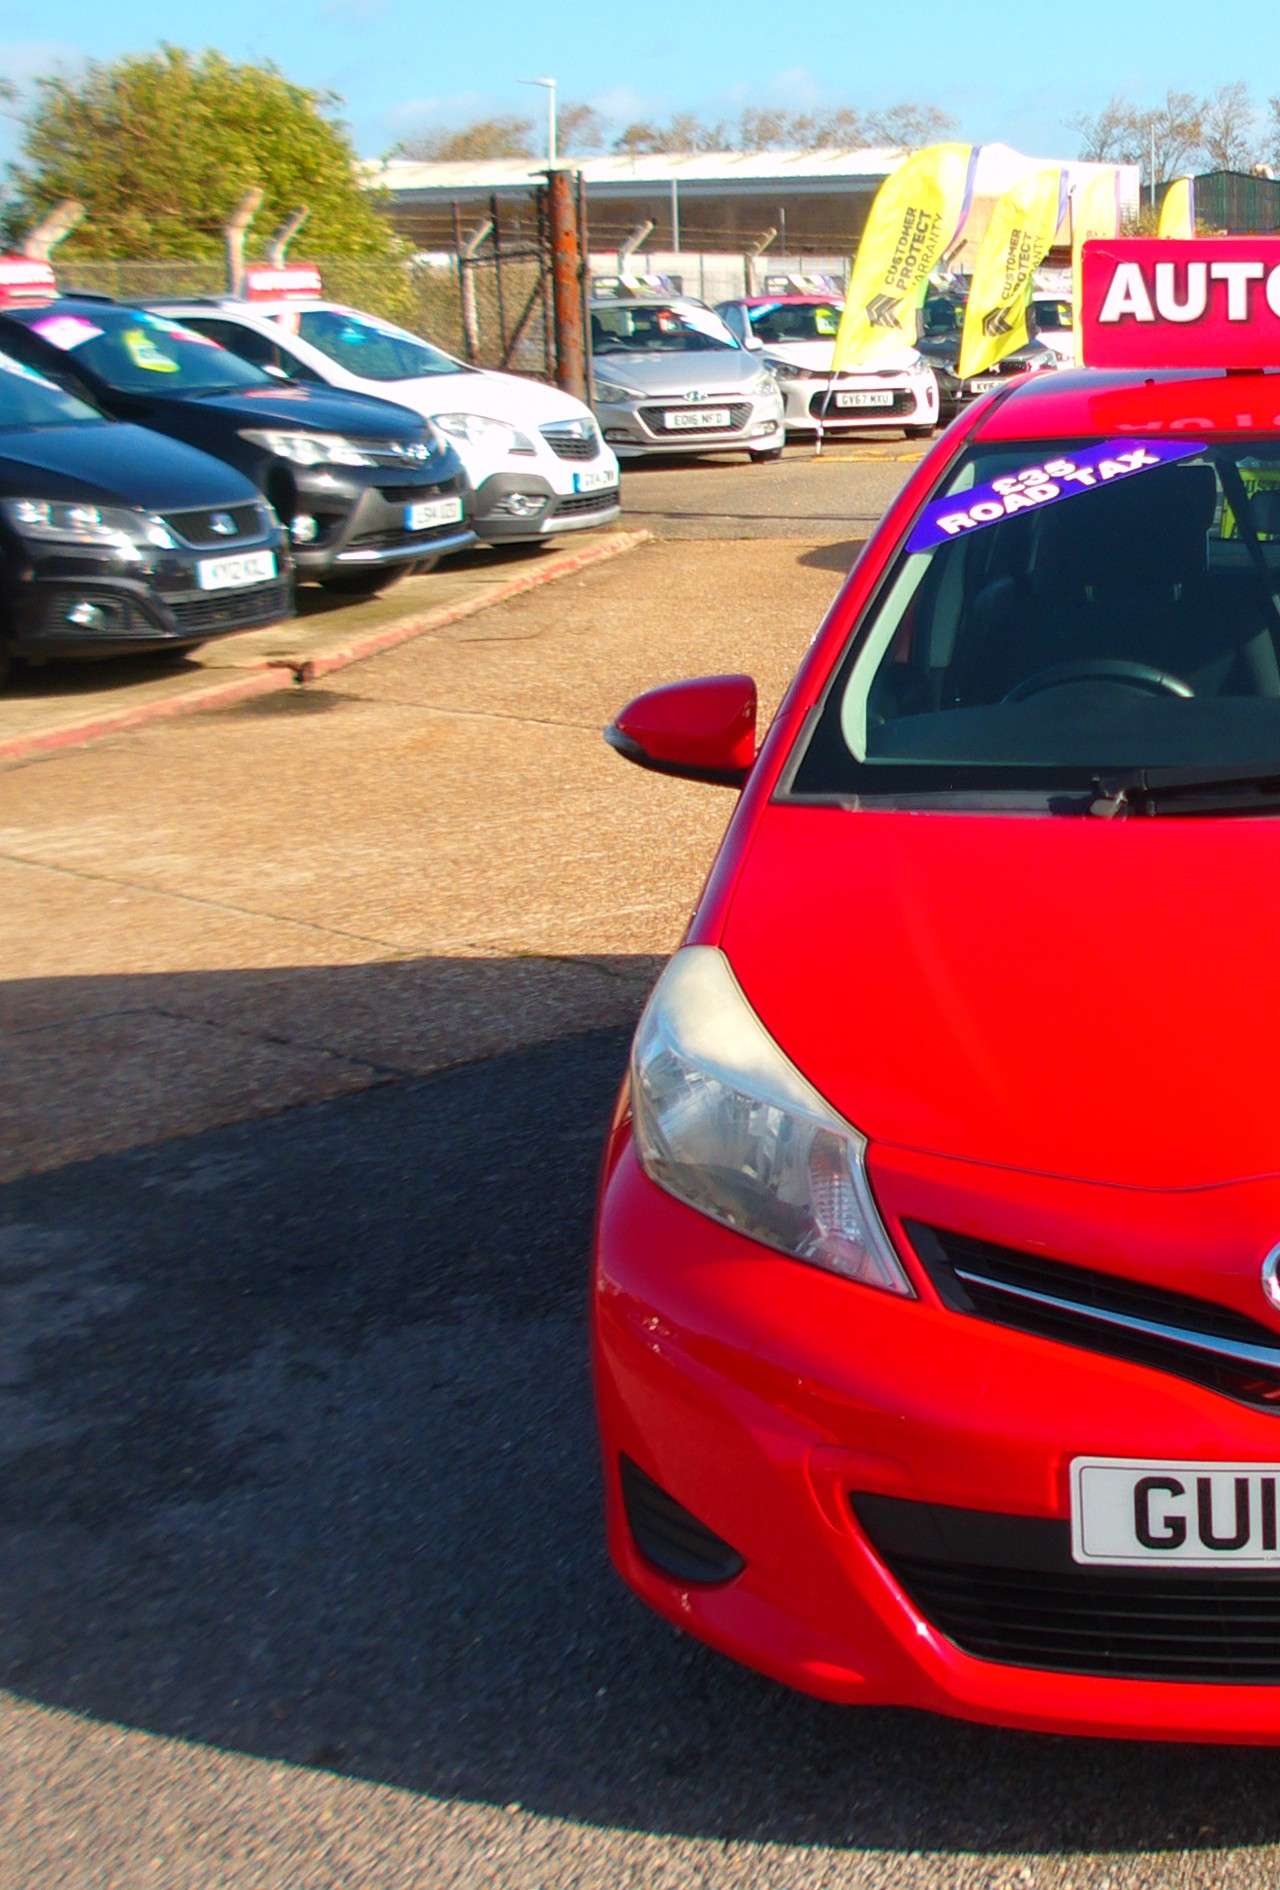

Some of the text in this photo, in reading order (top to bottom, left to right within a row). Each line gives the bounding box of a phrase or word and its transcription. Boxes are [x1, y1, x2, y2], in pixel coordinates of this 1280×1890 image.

[885, 206, 917, 285] CUSTOMER
[896, 209, 931, 290] PROTECT
[912, 212, 943, 285] ARRANTY
[1001, 228, 1022, 300] CUSTOMER
[1010, 232, 1032, 297] OTECT
[936, 448, 1161, 535] ROAD TAX
[991, 458, 1077, 496] £35
